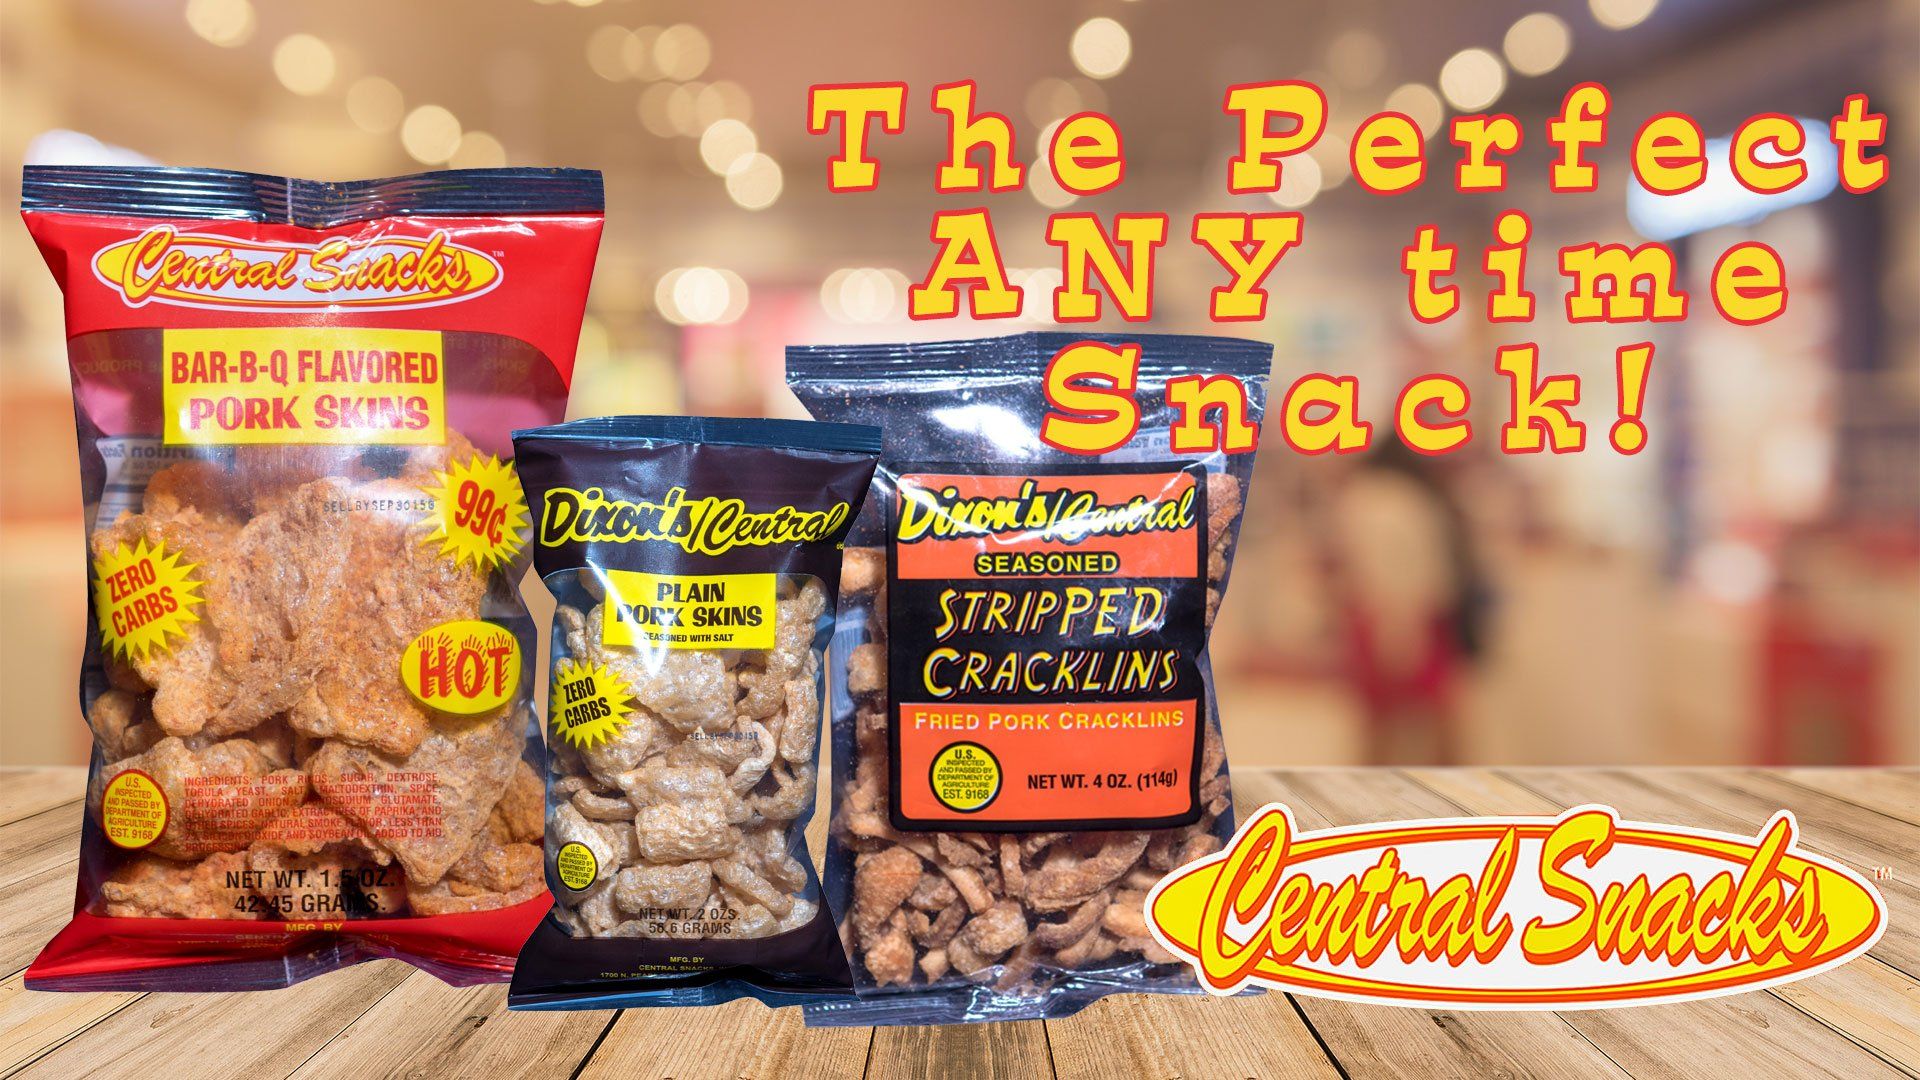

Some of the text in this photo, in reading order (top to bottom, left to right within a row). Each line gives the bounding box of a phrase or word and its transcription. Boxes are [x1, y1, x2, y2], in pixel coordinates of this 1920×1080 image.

[122, 226, 297, 299] Central
[301, 230, 473, 293] Snacks
[171, 349, 438, 387] BAR-B-Q FLAVORED
[189, 394, 430, 430] PORK SKINS
[455, 480, 508, 548] 99¢
[977, 553, 1118, 573] SEASONED
[105, 558, 156, 603] ZERO
[657, 582, 725, 603] PLAIN
[112, 586, 178, 637] CARBS
[616, 604, 762, 628] PORK SKINS
[935, 586, 1168, 642] STRIPPED
[643, 631, 734, 642] SEASONED WITH SALT
[419, 636, 512, 699] HOT
[923, 647, 1180, 699] CRACKLINS
[563, 676, 596, 704] ZERO
[564, 697, 611, 728] CARBS
[915, 710, 1184, 730] FRIED PORK CRACKLINS
[954, 749, 976, 759] U.S.
[125, 776, 141, 788] U.S.
[184, 775, 253, 786] INGREDIENTS:
[261, 775, 288, 785] PORK
[1028, 768, 1178, 791] NET WT. 4 OZ. (114g)
[115, 788, 152, 799] INSPECTED
[185, 788, 223, 797] TORULA
[236, 786, 269, 797] YEAST,
[942, 789, 989, 799] EST. 9168
[121, 799, 148, 808] PASSED
[151, 801, 160, 810] BY
[185, 799, 249, 808] DEHYDRATED
[360, 807, 371, 816] OF
[374, 806, 415, 816] PAPRIKA
[422, 806, 442, 816] AND
[105, 807, 162, 819] DEPARTMENT OF
[109, 817, 157, 829] AGRICULTURE
[261, 819, 306, 828] NATURAL
[308, 818, 342, 828] SMOKE
[390, 818, 413, 827] LESS
[416, 817, 442, 826] THAN
[110, 827, 153, 840] EST. 9168
[287, 830, 305, 840] AND
[310, 829, 355, 839] SOYBEAN
[375, 828, 407, 838] ADDED
[411, 828, 422, 837] TO
[425, 828, 442, 837] AID
[226, 870, 266, 888] NET
[274, 870, 311, 888] WT.
[361, 868, 395, 887] OZ.
[639, 908, 740, 920] NET WT. 2 OZS.
[649, 922, 731, 934] 56.6 GRAMS
